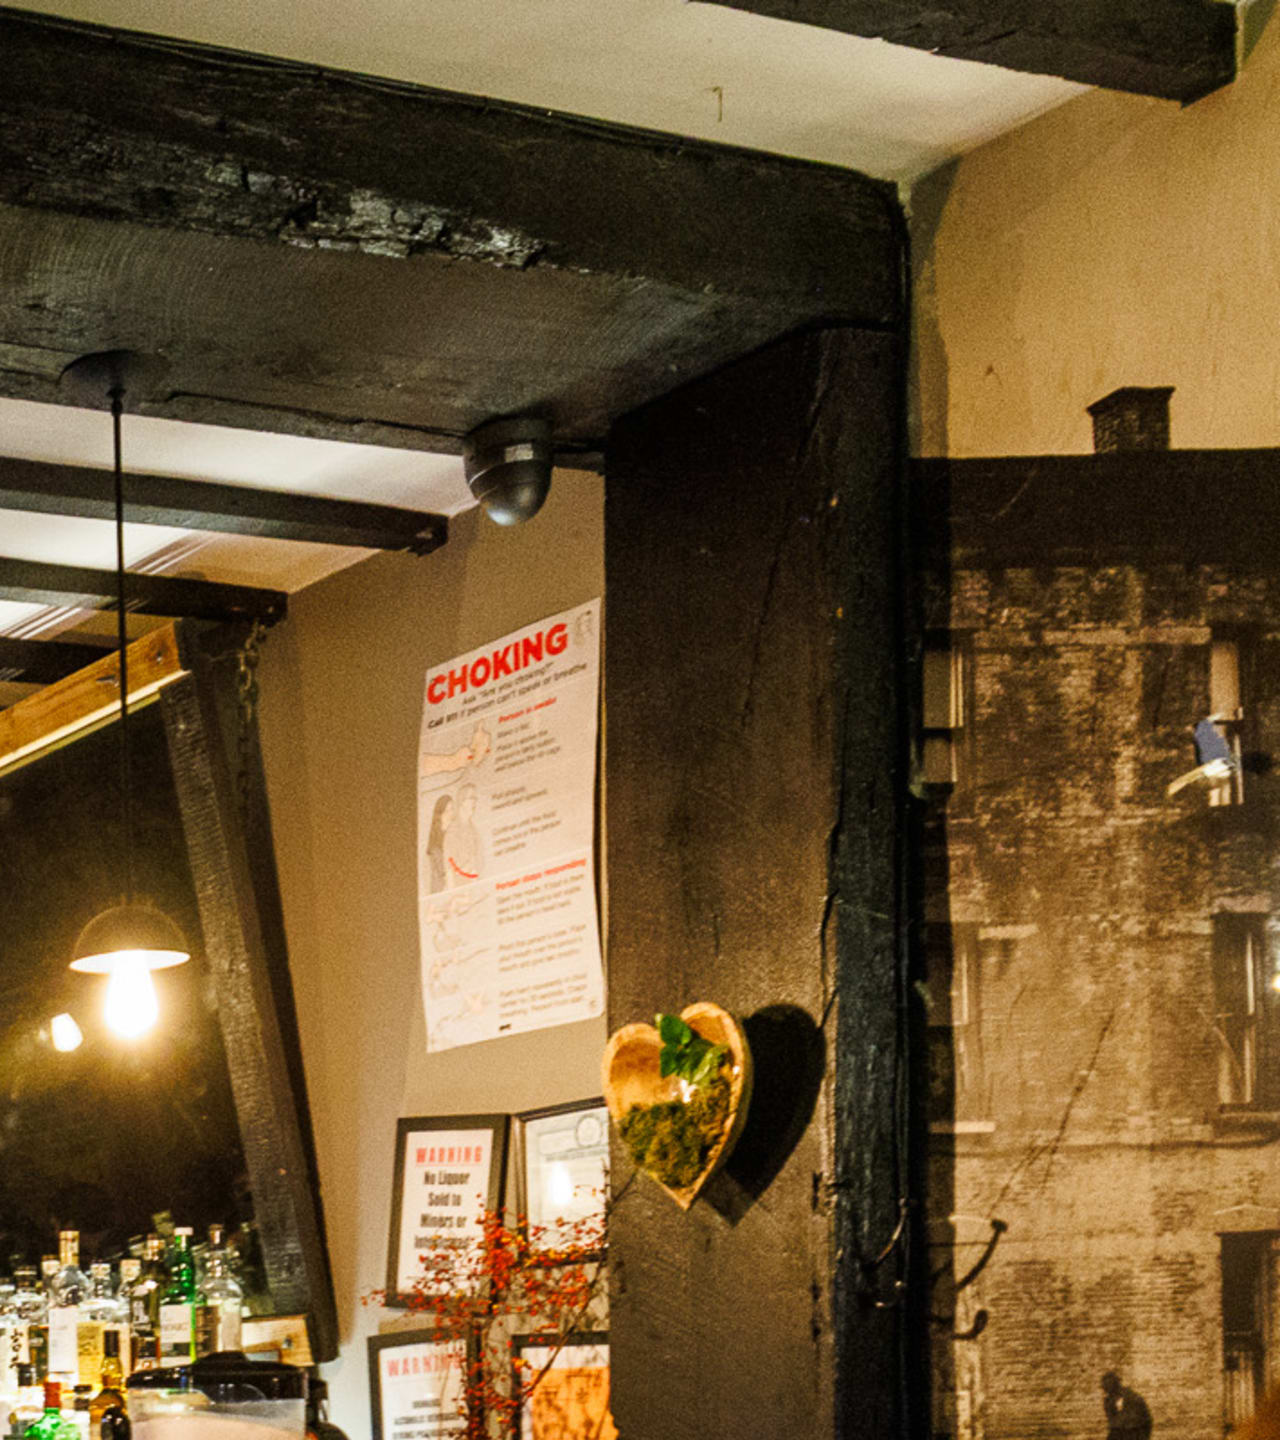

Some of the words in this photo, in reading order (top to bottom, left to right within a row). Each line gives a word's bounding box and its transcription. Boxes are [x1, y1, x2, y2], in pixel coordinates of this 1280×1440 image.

[427, 623, 568, 704] CHOKING
[427, 716, 444, 729] Call
[446, 712, 458, 723] 911
[467, 699, 495, 716] person
[554, 663, 588, 681] breathe
[416, 1146, 483, 1164] WARNING
[424, 1171, 436, 1186] No
[438, 1170, 471, 1187] Liquor
[428, 1192, 450, 1207] Sold
[451, 1193, 462, 1207] to
[420, 1213, 454, 1228] Minors
[456, 1215, 468, 1228] or
